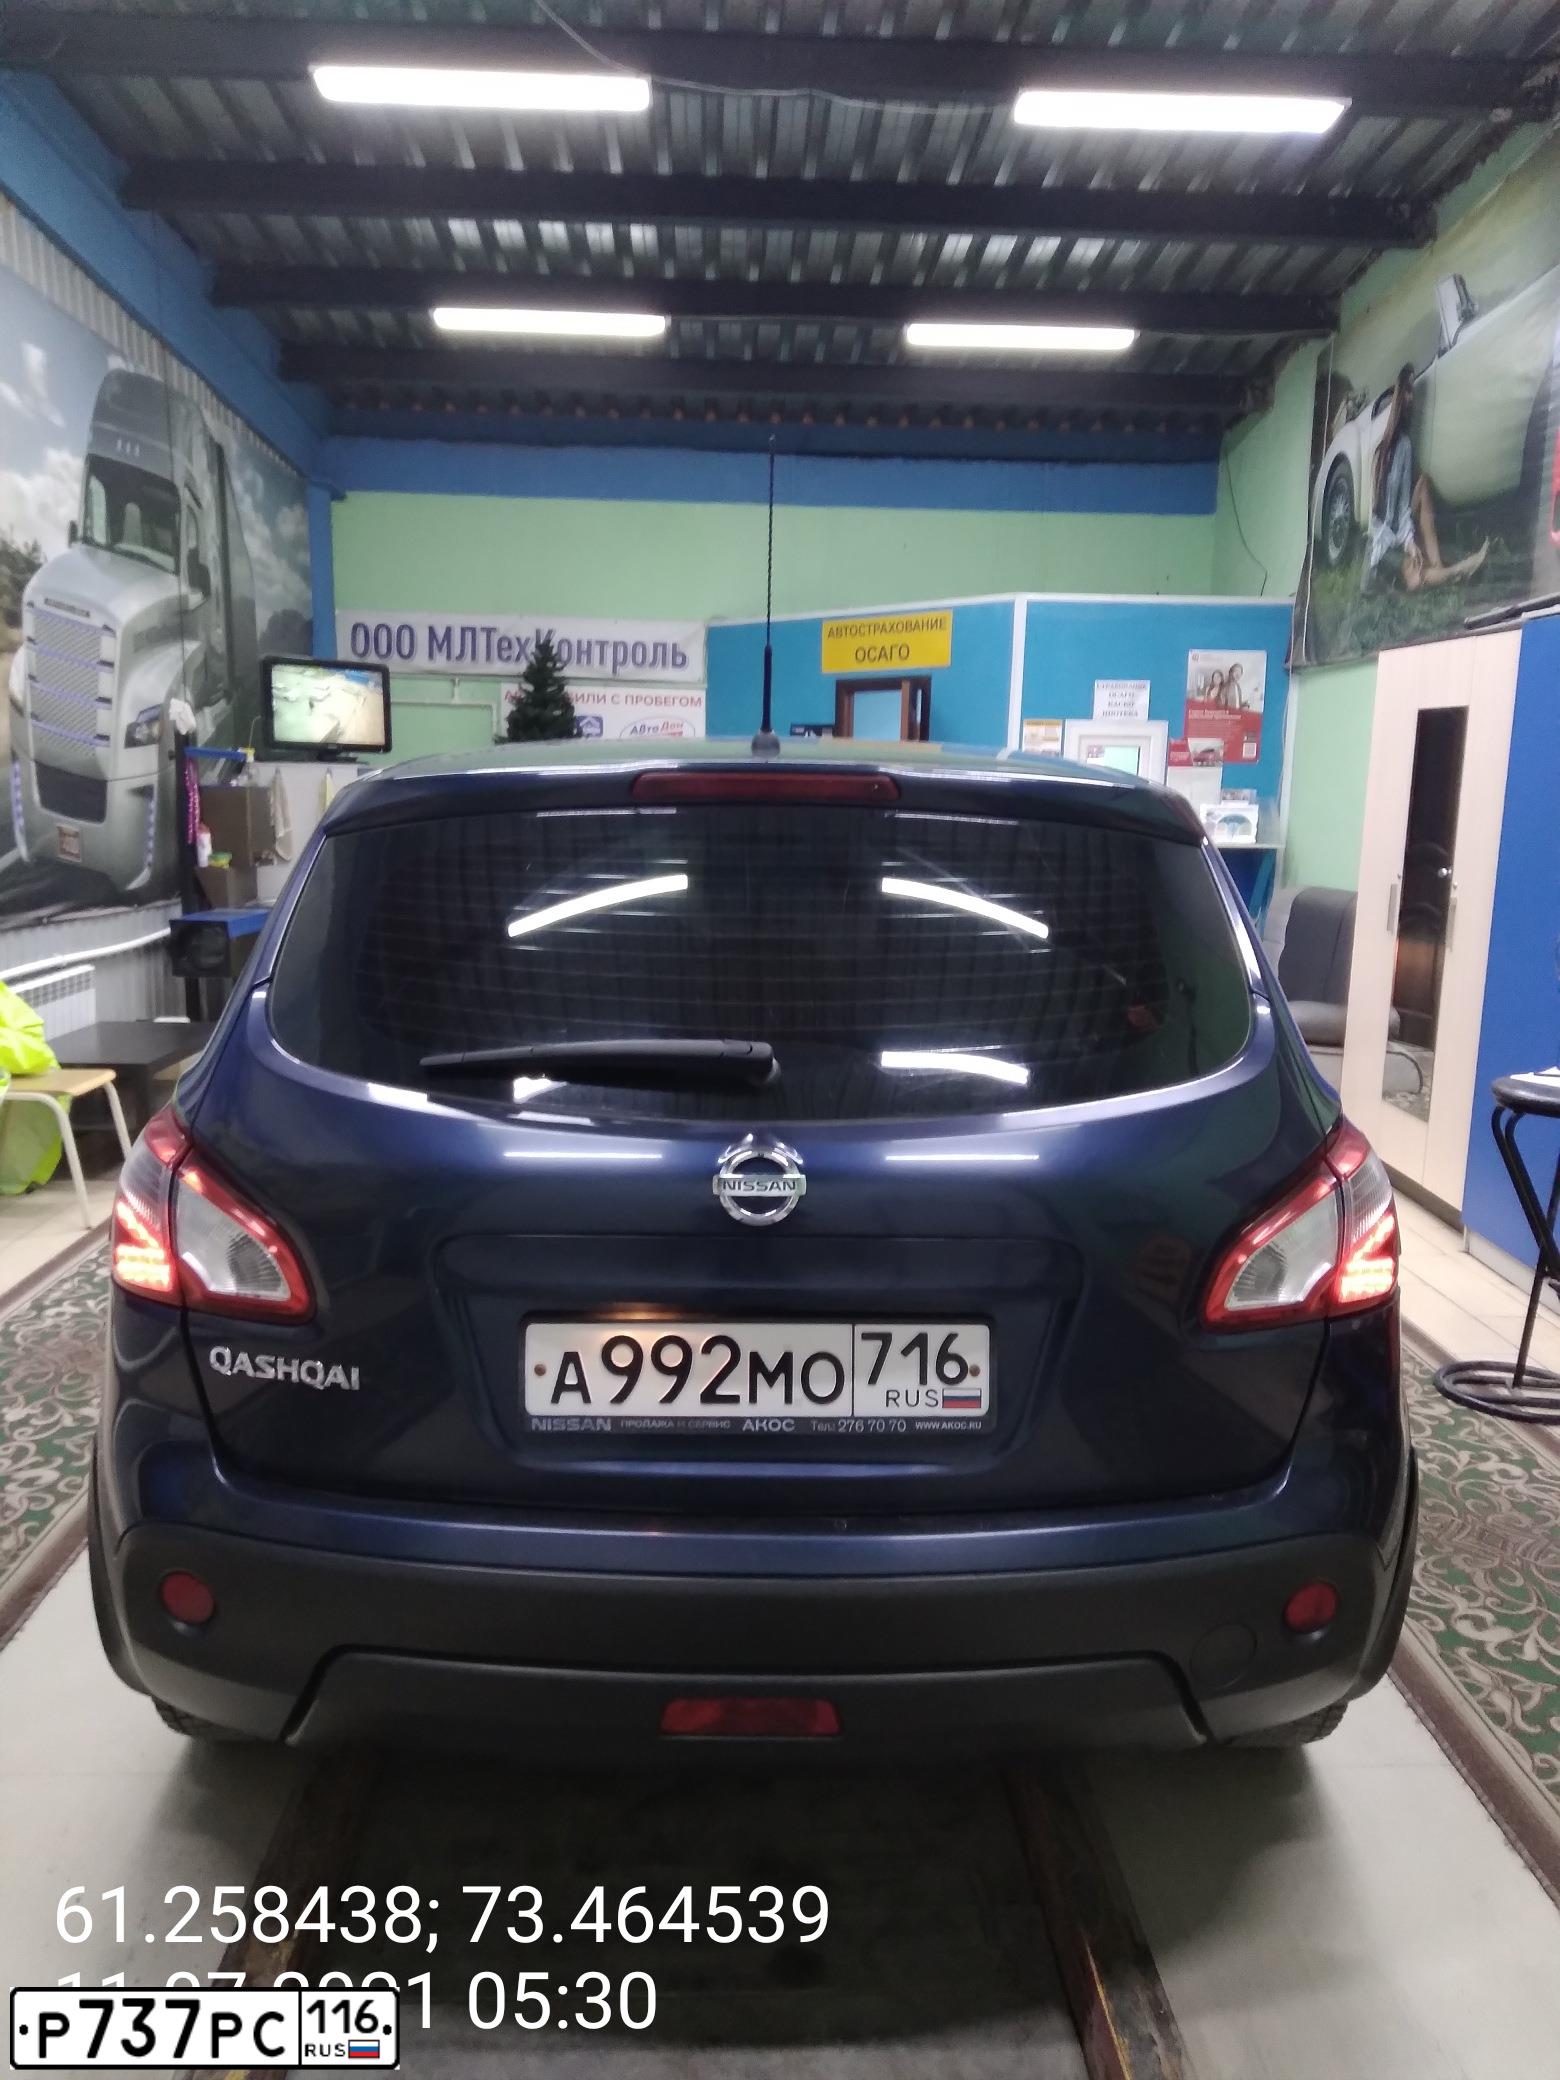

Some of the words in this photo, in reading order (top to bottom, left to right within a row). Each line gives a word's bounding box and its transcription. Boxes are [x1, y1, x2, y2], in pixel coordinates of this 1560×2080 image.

[827, 617, 946, 639] АВТОСТРАХОВАНИЕ
[351, 622, 415, 660] ООО
[855, 643, 910, 663] ОСАГО
[625, 694, 702, 707] ПРОБЕГОМ
[723, 1180, 796, 1191] NISSAN
[209, 1345, 360, 1391] QASHQAI
[551, 1335, 845, 1404] А992МО
[861, 1332, 970, 1386] 716
[885, 1390, 939, 1408] RUS
[531, 1418, 612, 1432] NISSAN
[838, 1419, 865, 1433] 276
[868, 1420, 886, 1433] 70
[889, 1420, 907, 1433] 70
